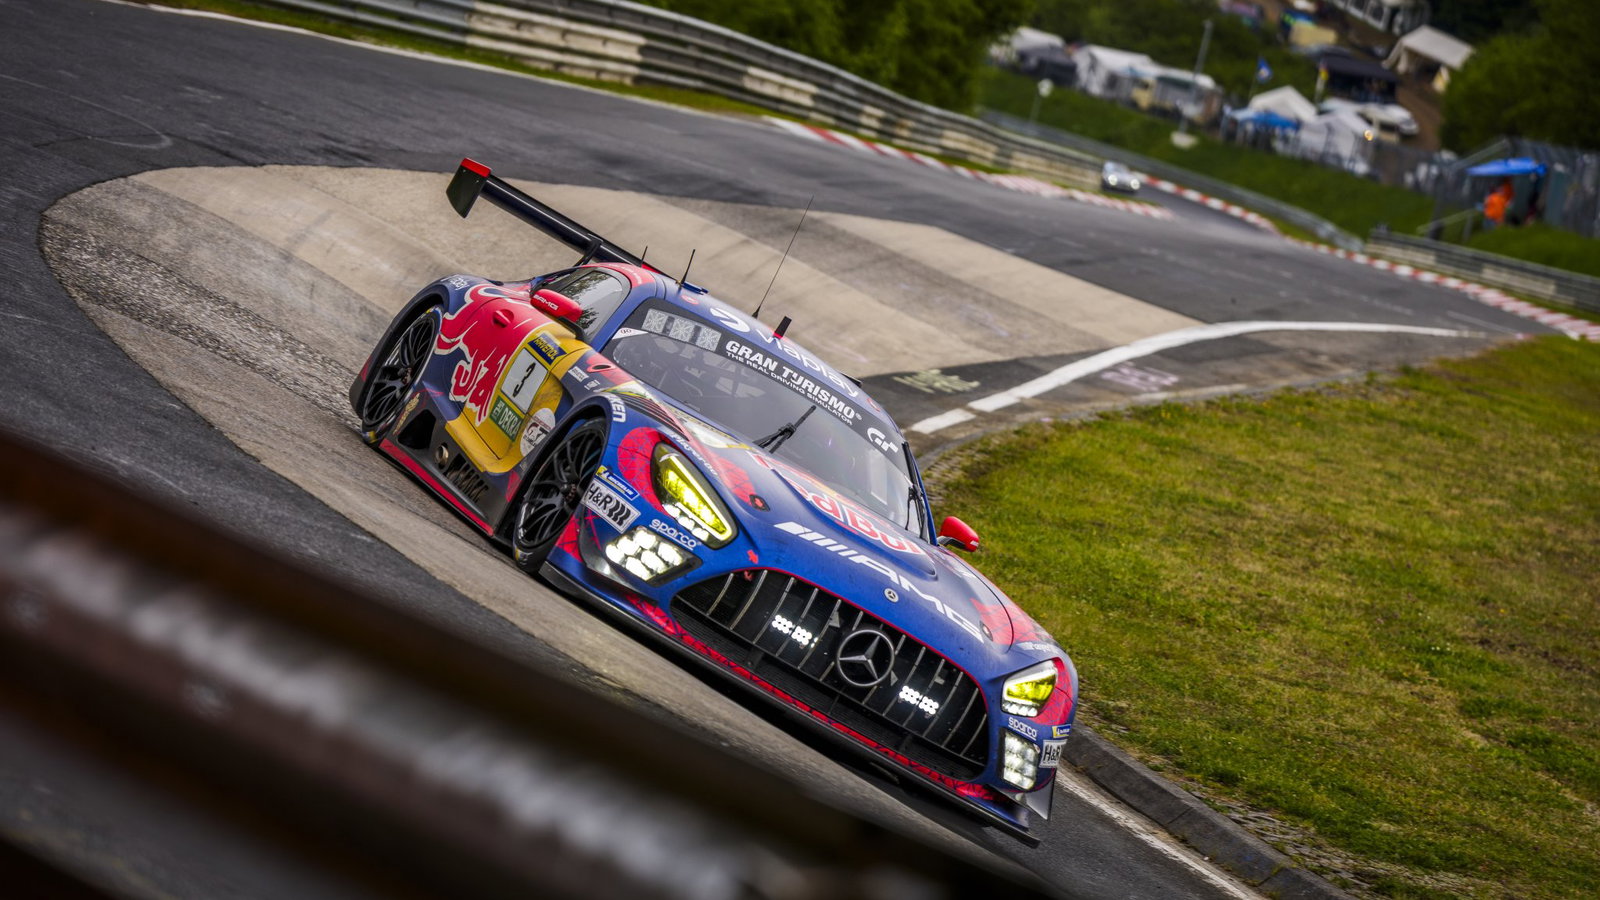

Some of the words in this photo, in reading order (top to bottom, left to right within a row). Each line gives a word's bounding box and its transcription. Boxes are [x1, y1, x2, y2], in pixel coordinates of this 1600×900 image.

[533, 337, 559, 360] RAVENOL
[725, 340, 779, 371] GRAN
[756, 329, 859, 397] viaplay
[512, 362, 536, 398] 3
[726, 351, 745, 363] THE
[748, 360, 770, 375] REAL
[770, 372, 806, 395] DRIVING
[806, 391, 853, 425] SIMULATOR
[498, 406, 524, 438] DEKRA
[587, 482, 613, 511] H&R
[650, 518, 697, 549] sparco
[852, 554, 985, 644] AMG
[1008, 716, 1037, 739] sparco
